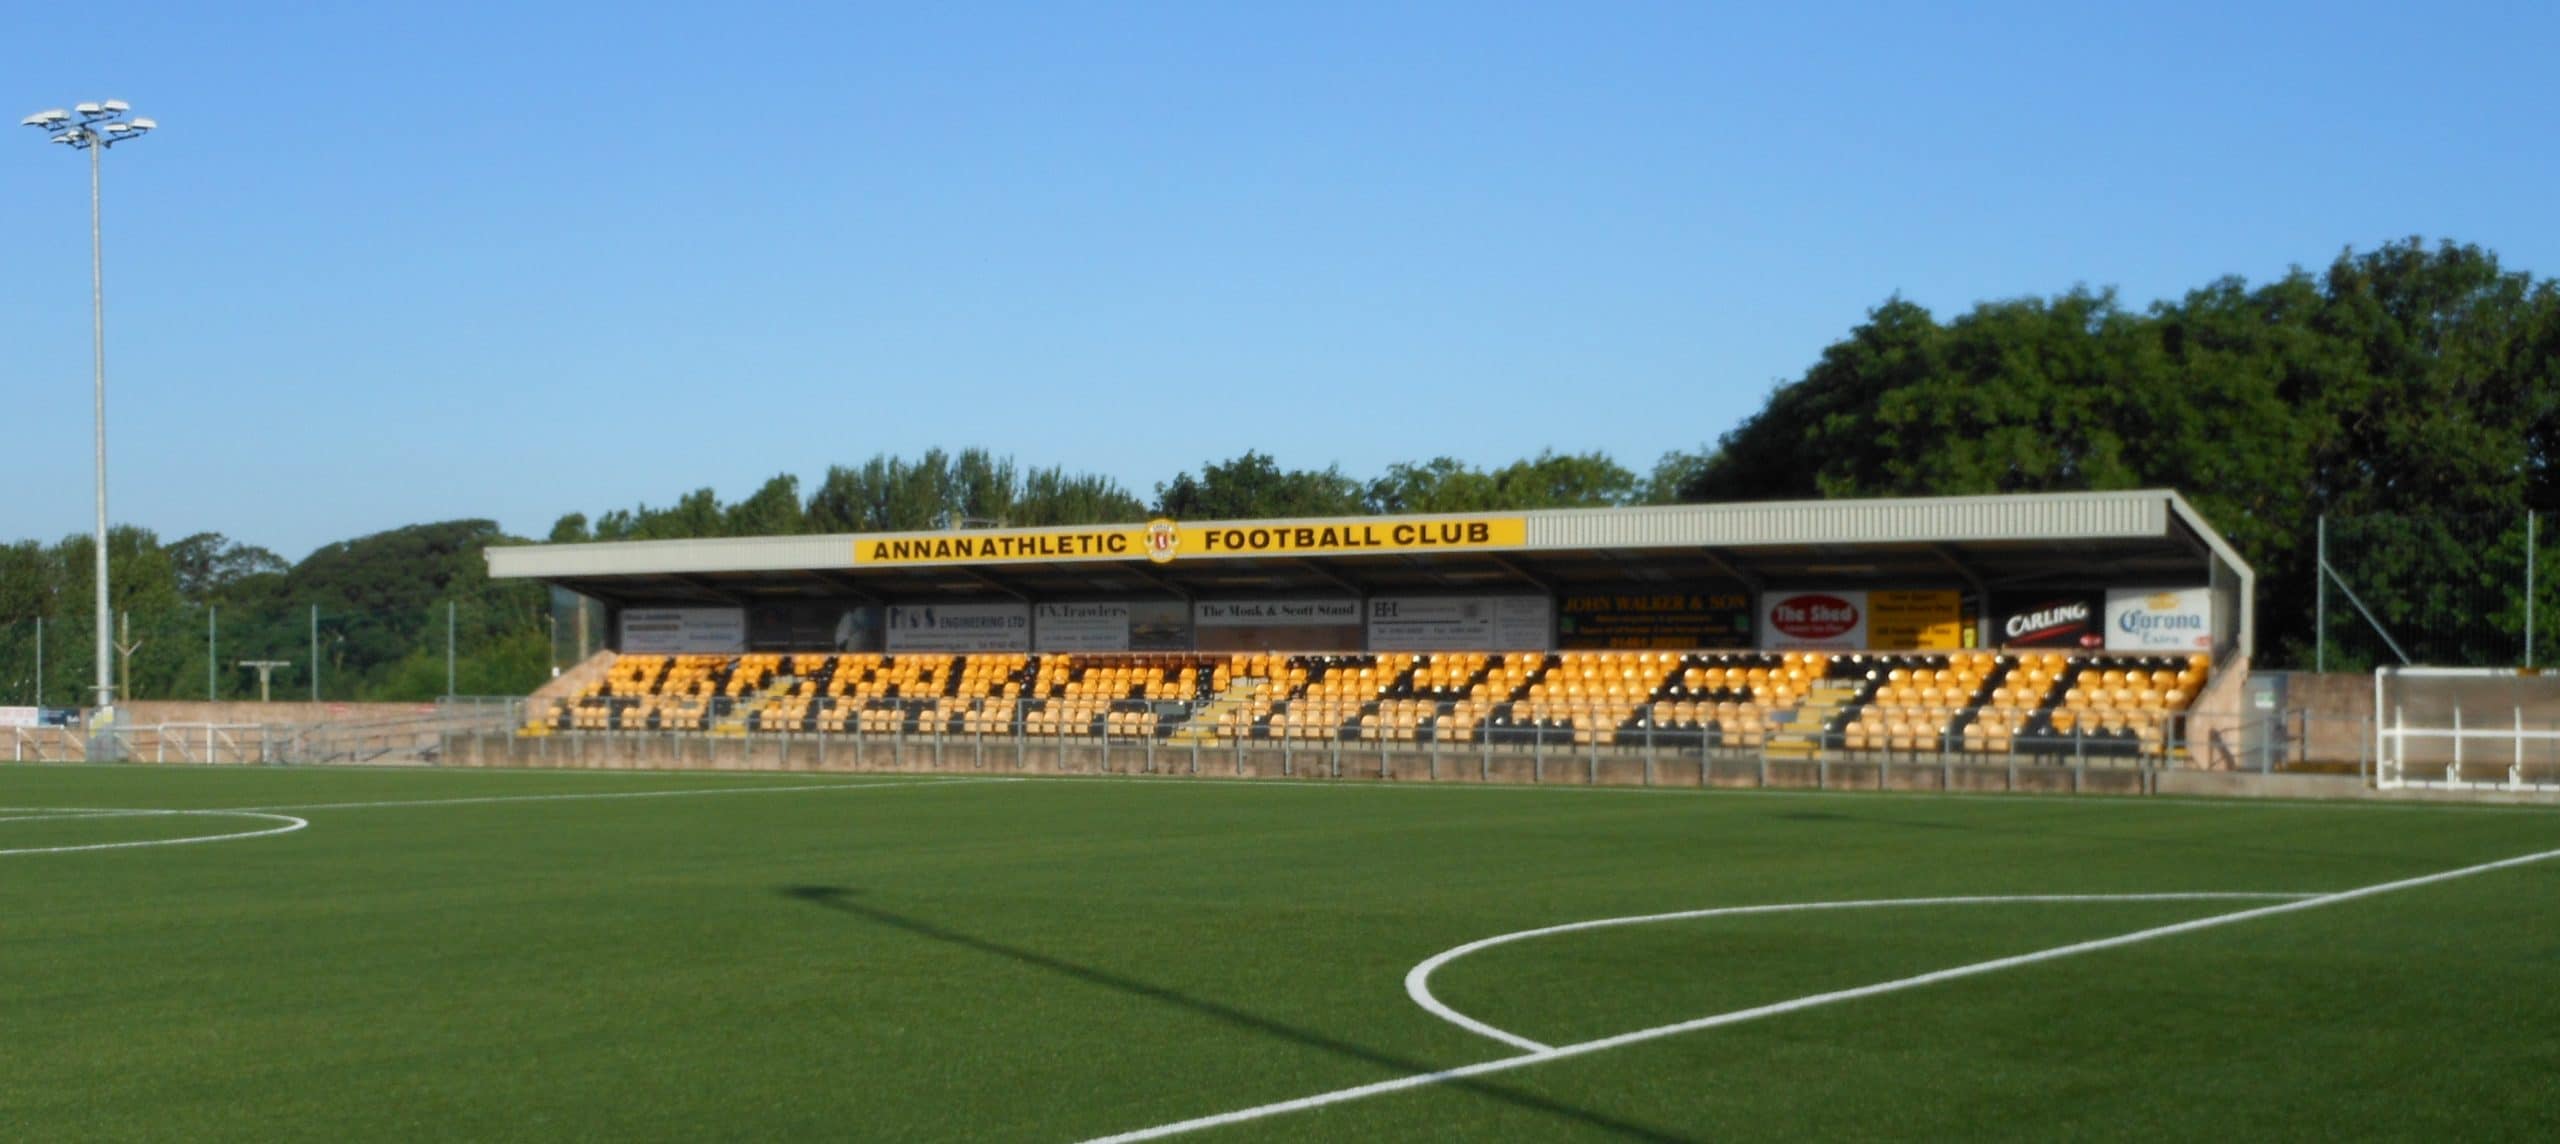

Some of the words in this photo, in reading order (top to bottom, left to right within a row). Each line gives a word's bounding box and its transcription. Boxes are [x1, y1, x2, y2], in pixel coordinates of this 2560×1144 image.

[873, 539, 973, 560] ANNAN
[980, 533, 1127, 556] ATHLETIC
[1205, 527, 1381, 550] FOOTBALL
[1392, 522, 1490, 545] CLUB
[1201, 605, 1224, 617] The
[1229, 604, 1263, 617] Monk
[1282, 604, 1313, 616] Scott
[1319, 603, 1354, 616] Stand
[1777, 605, 1805, 622] The
[1810, 605, 1853, 622] Shed
[2005, 601, 2090, 637] CARLING
[1008, 615, 1025, 628] LTD
[2119, 609, 2202, 635] Corona
